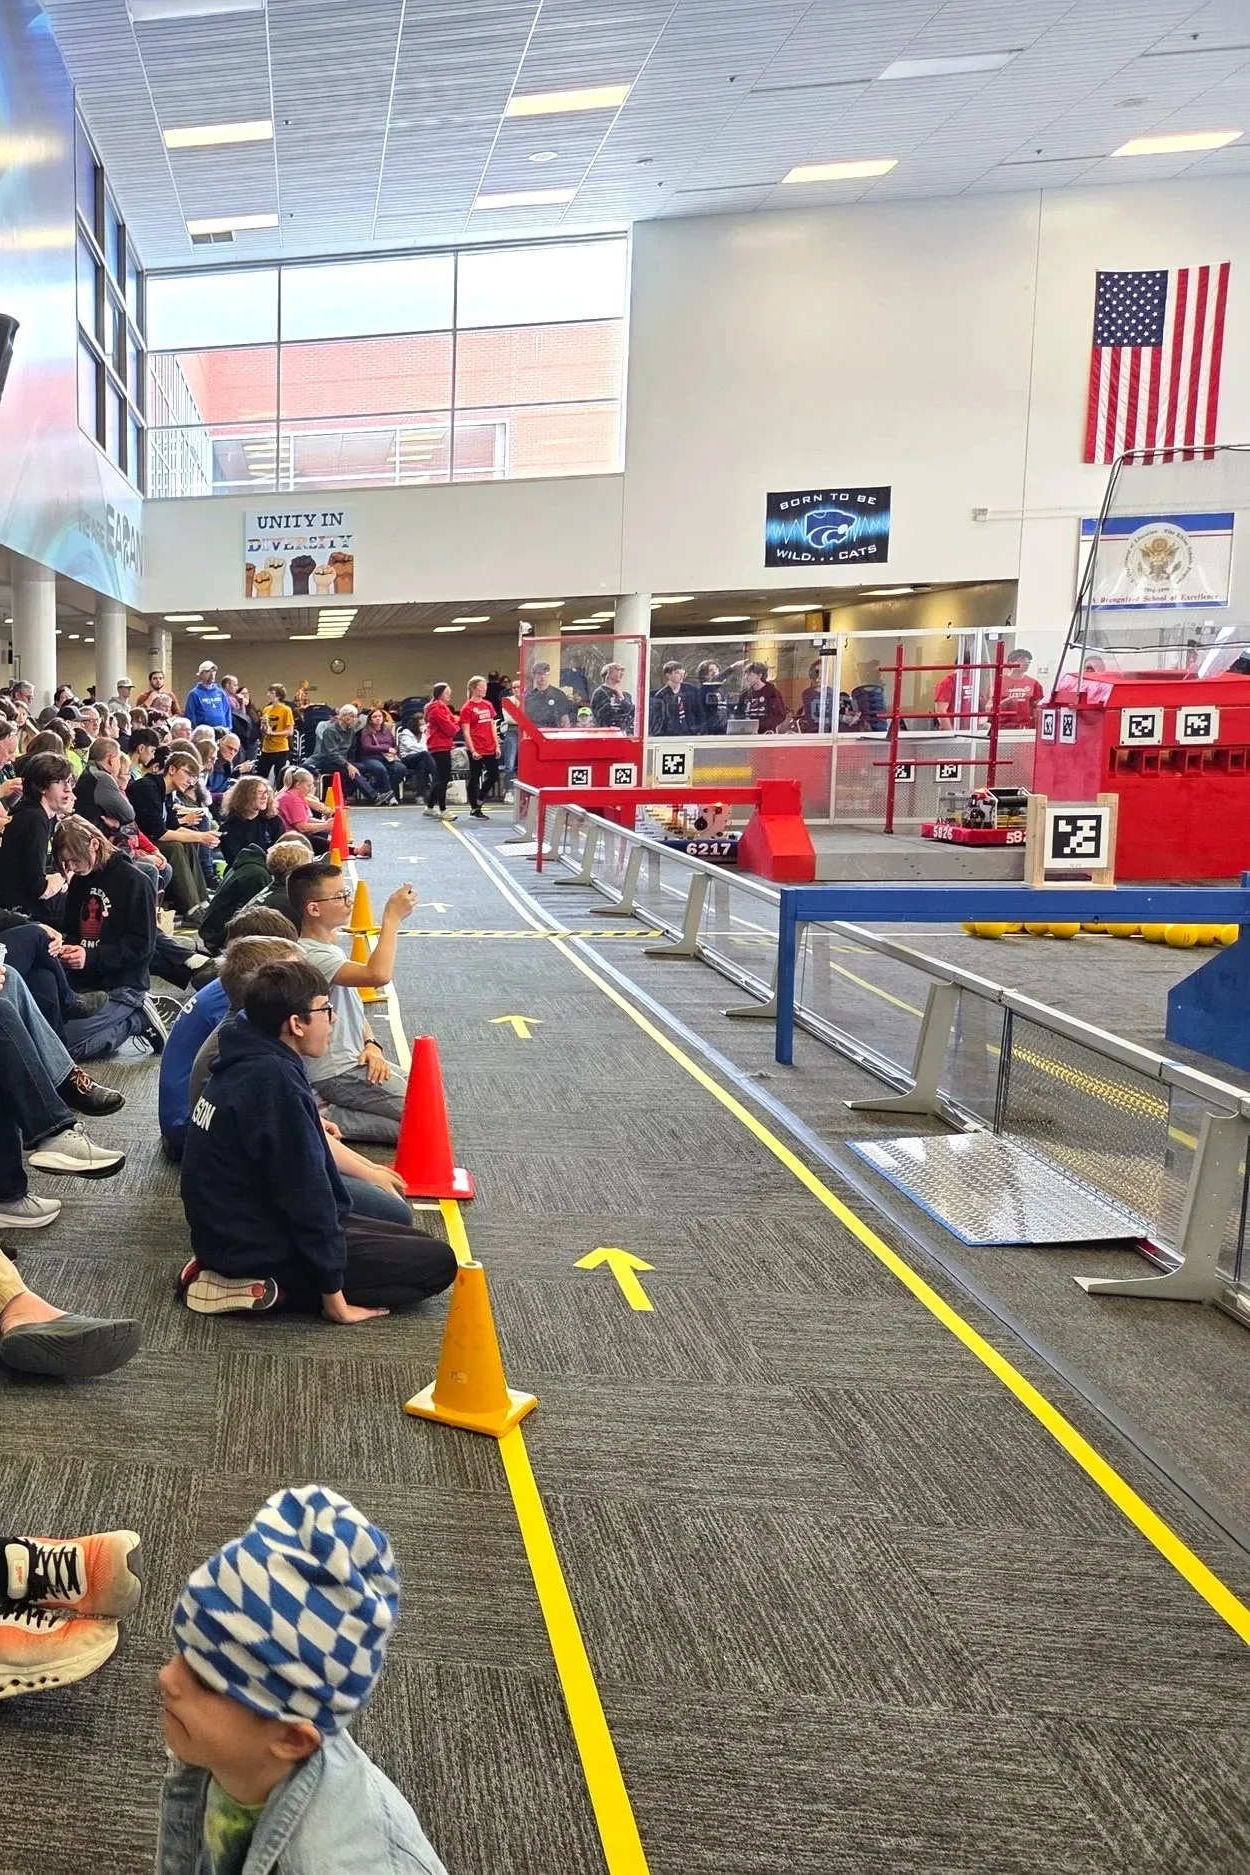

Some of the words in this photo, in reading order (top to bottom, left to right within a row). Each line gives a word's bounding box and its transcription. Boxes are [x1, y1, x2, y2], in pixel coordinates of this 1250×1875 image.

[779, 494, 823, 511] BORN
[830, 493, 849, 501] TO
[857, 494, 877, 505] BE
[257, 514, 317, 529] UNITY
[321, 512, 344, 527] IN
[247, 535, 353, 552] DIVERSITY
[838, 544, 877, 560] CATS
[933, 826, 953, 840] 5826
[686, 842, 731, 856] 6217
